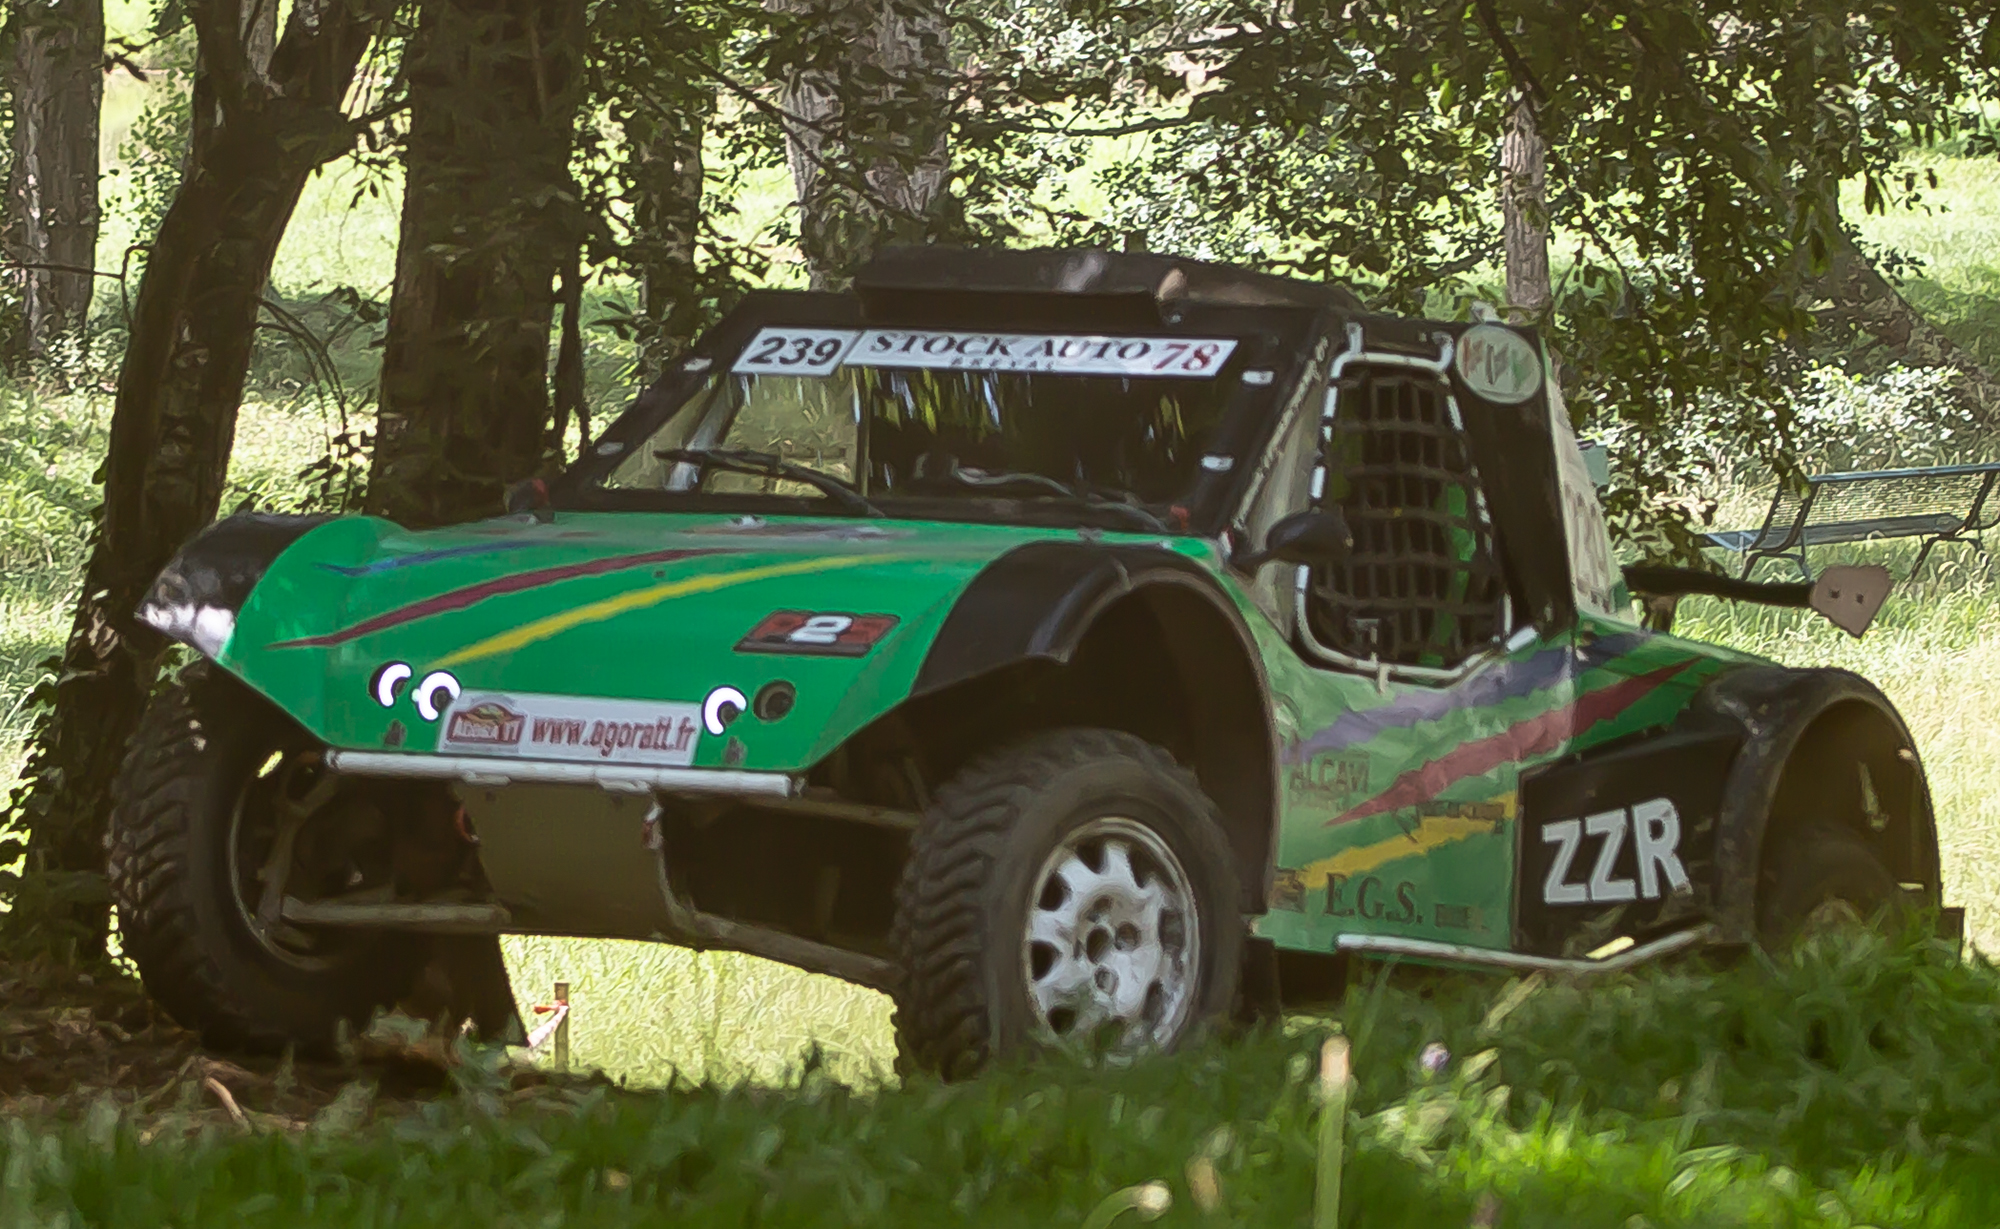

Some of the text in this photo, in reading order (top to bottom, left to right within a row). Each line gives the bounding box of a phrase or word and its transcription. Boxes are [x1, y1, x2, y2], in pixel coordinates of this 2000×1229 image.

[748, 336, 843, 366] 239
[870, 331, 1221, 371] STOCK AUTO 78
[790, 615, 852, 644] 2
[1542, 797, 1694, 904] ZZR
